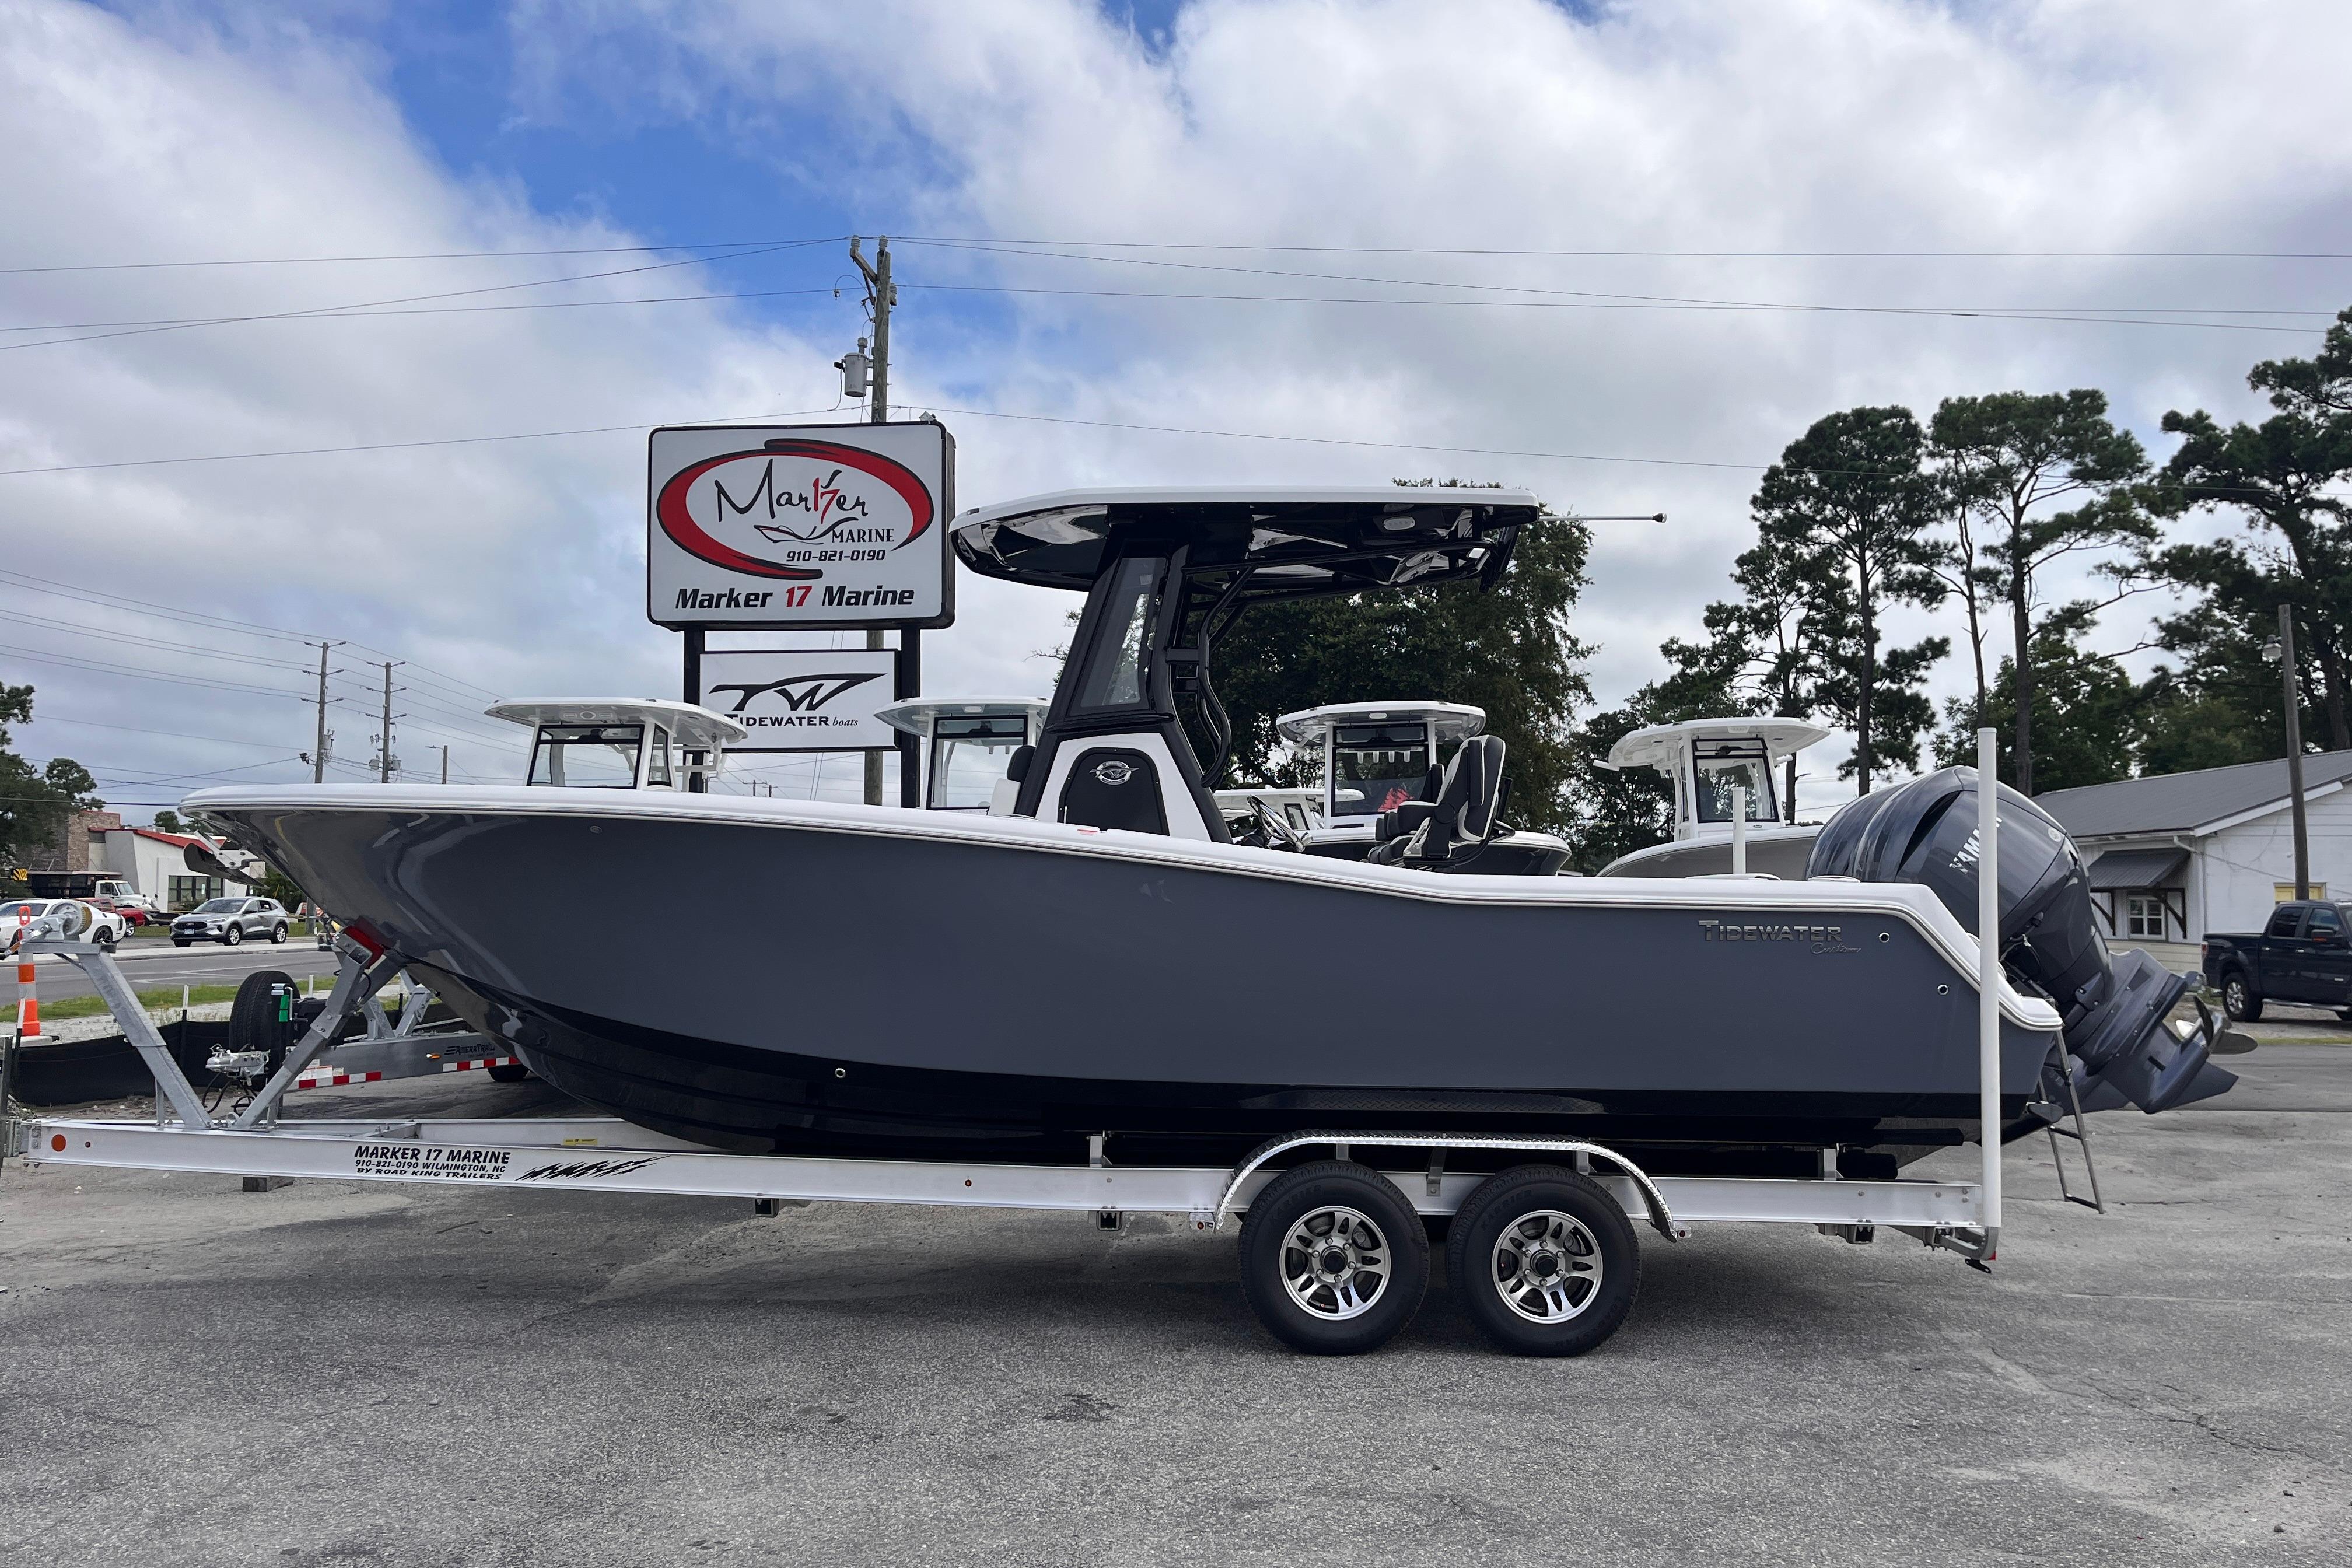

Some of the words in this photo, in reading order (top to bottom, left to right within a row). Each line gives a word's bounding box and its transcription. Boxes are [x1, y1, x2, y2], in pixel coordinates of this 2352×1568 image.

[832, 528, 895, 543] MARINE
[786, 549, 886, 562] 910-821-0190
[676, 587, 773, 609] Marker
[786, 585, 813, 607] 17
[822, 585, 915, 606] Marine
[724, 713, 830, 726] TIDEWATER
[832, 716, 859, 727] boats
[1949, 817, 2003, 874] YAM
[1698, 920, 1843, 943] TIDEWATER
[1810, 942, 1862, 955] Custom
[354, 1146, 421, 1161] MARKER
[425, 1149, 443, 1161] 17
[446, 1149, 511, 1164] MARINE
[355, 1159, 419, 1169] 910-821-0190
[422, 1162, 489, 1173] WILMINGTON,
[446, 1171, 502, 1180] TRAILERS
